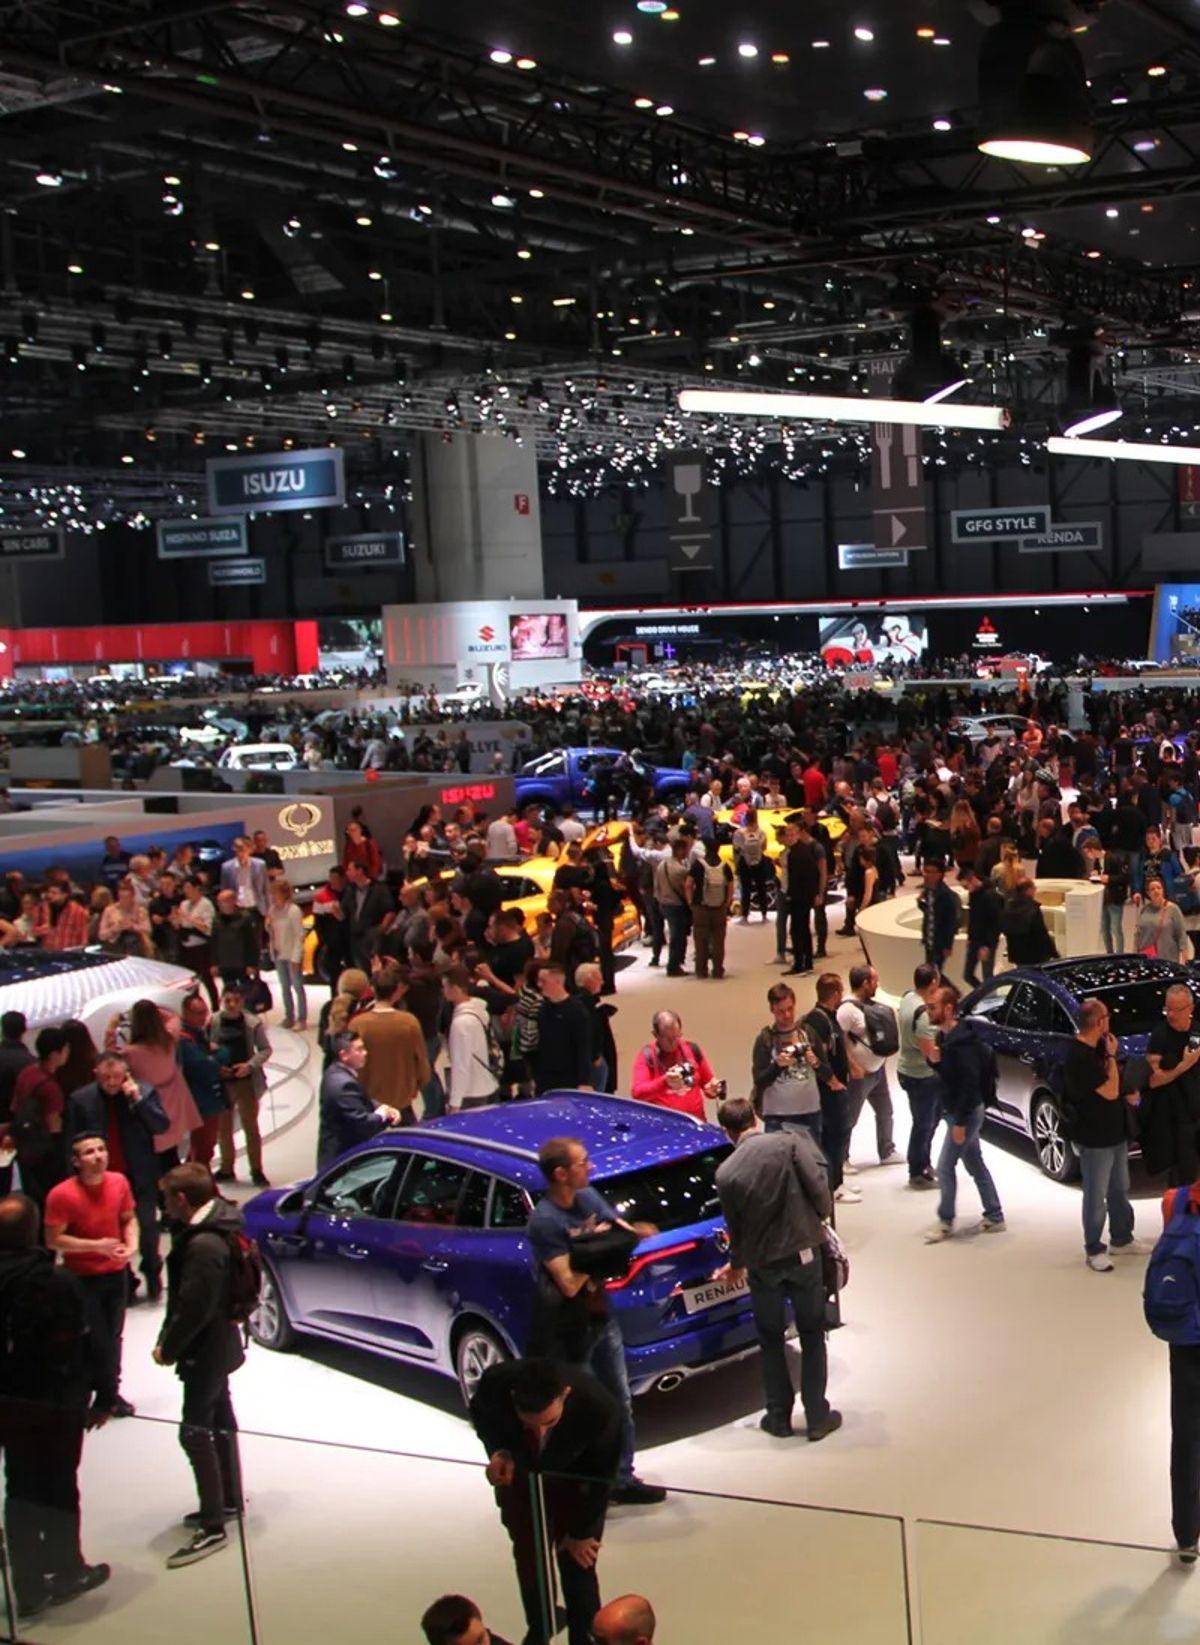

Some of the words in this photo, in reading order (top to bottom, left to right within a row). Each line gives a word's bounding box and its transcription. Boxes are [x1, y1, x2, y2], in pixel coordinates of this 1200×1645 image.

[243, 469, 305, 495] ISUZU
[965, 520, 993, 533] GFG
[996, 516, 1036, 530] STYLE
[341, 543, 387, 558] SUZUKI
[468, 644, 506, 652] SUZUKI
[442, 784, 495, 804] ISUZU
[694, 1280, 745, 1304] RENAU
